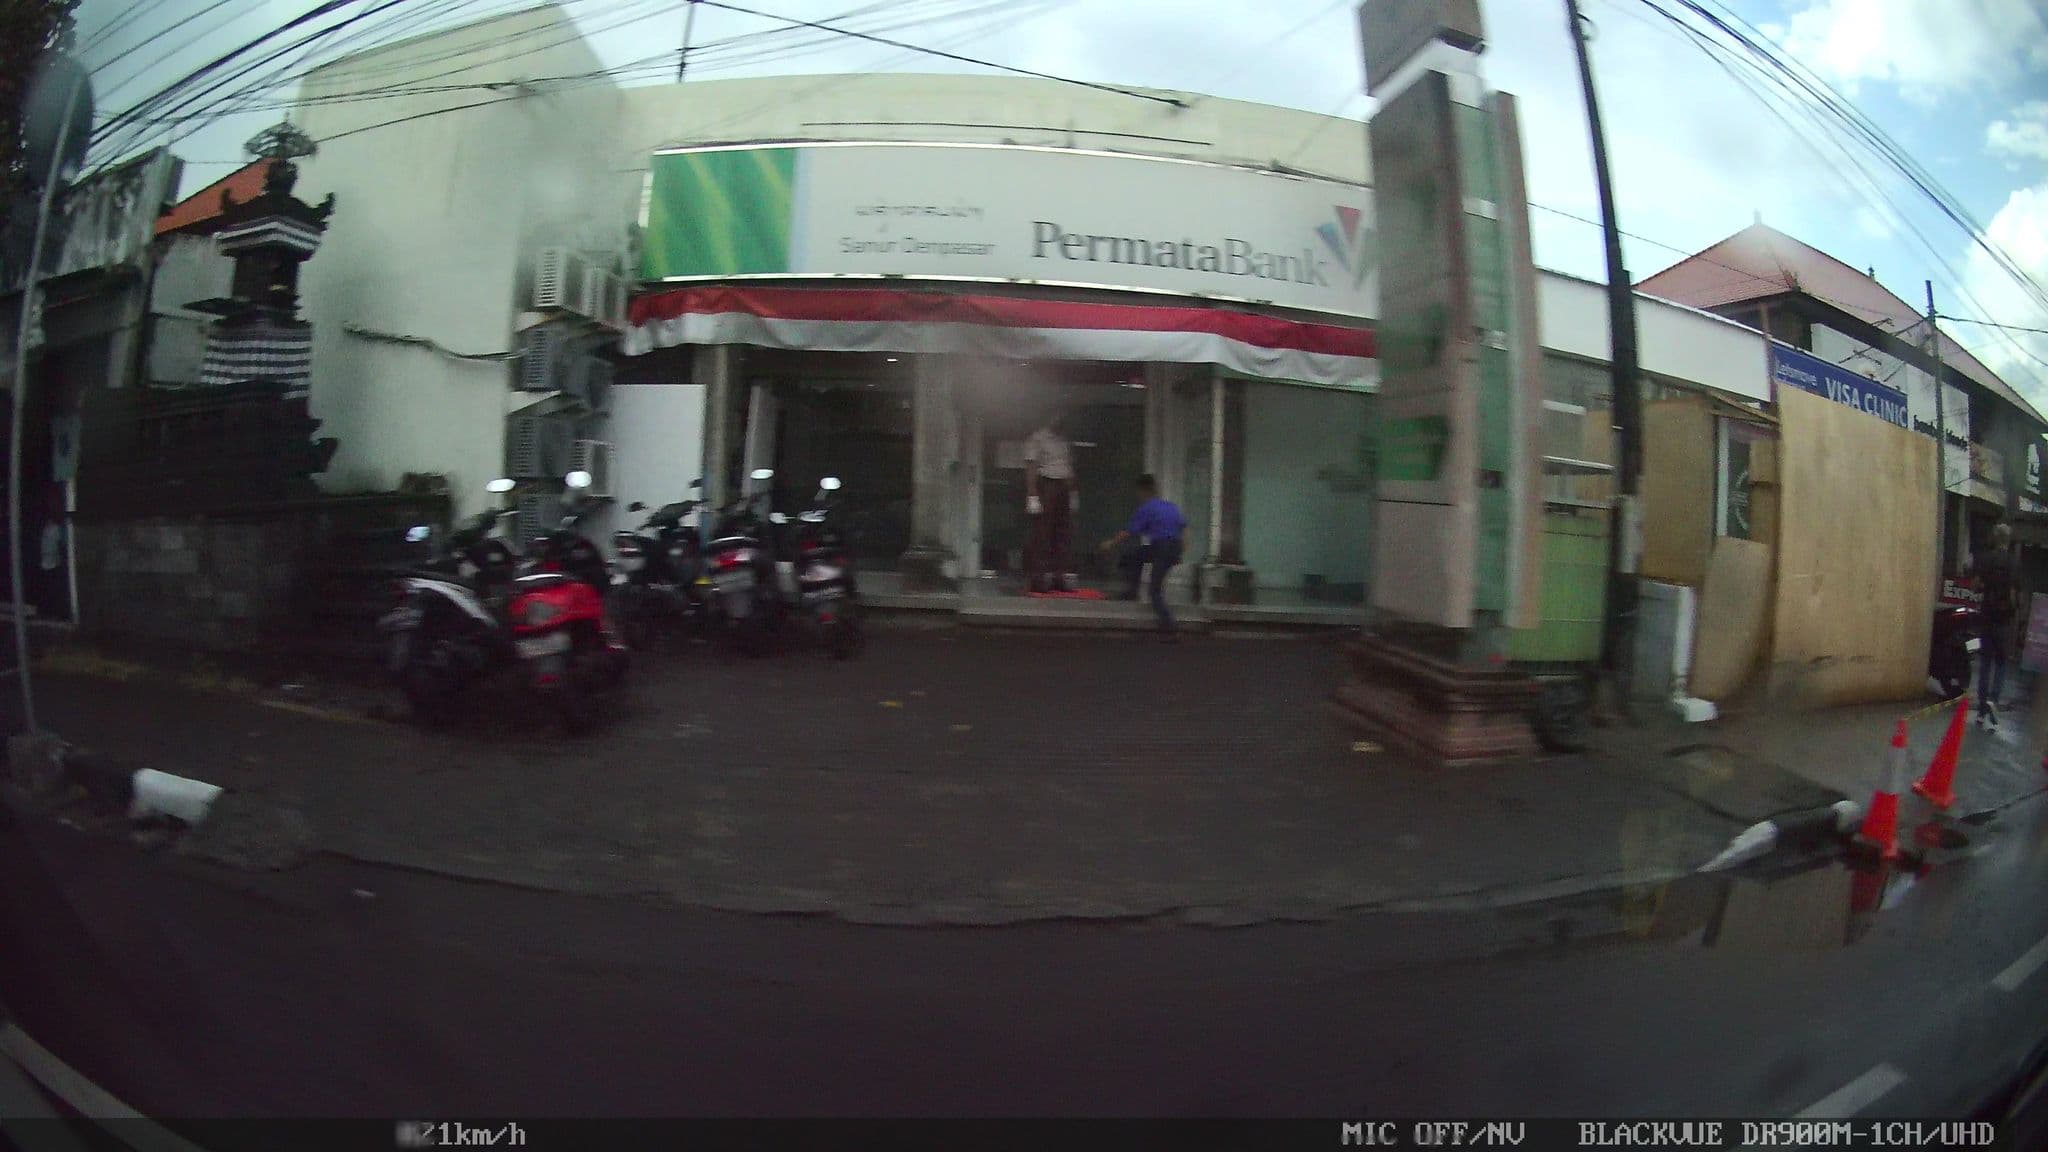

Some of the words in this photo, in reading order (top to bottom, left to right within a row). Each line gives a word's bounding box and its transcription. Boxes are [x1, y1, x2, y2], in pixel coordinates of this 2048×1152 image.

[1032, 219, 1328, 288] PermataBank
[1824, 376, 1861, 409] VISA
[1864, 392, 1908, 429] CLINIC
